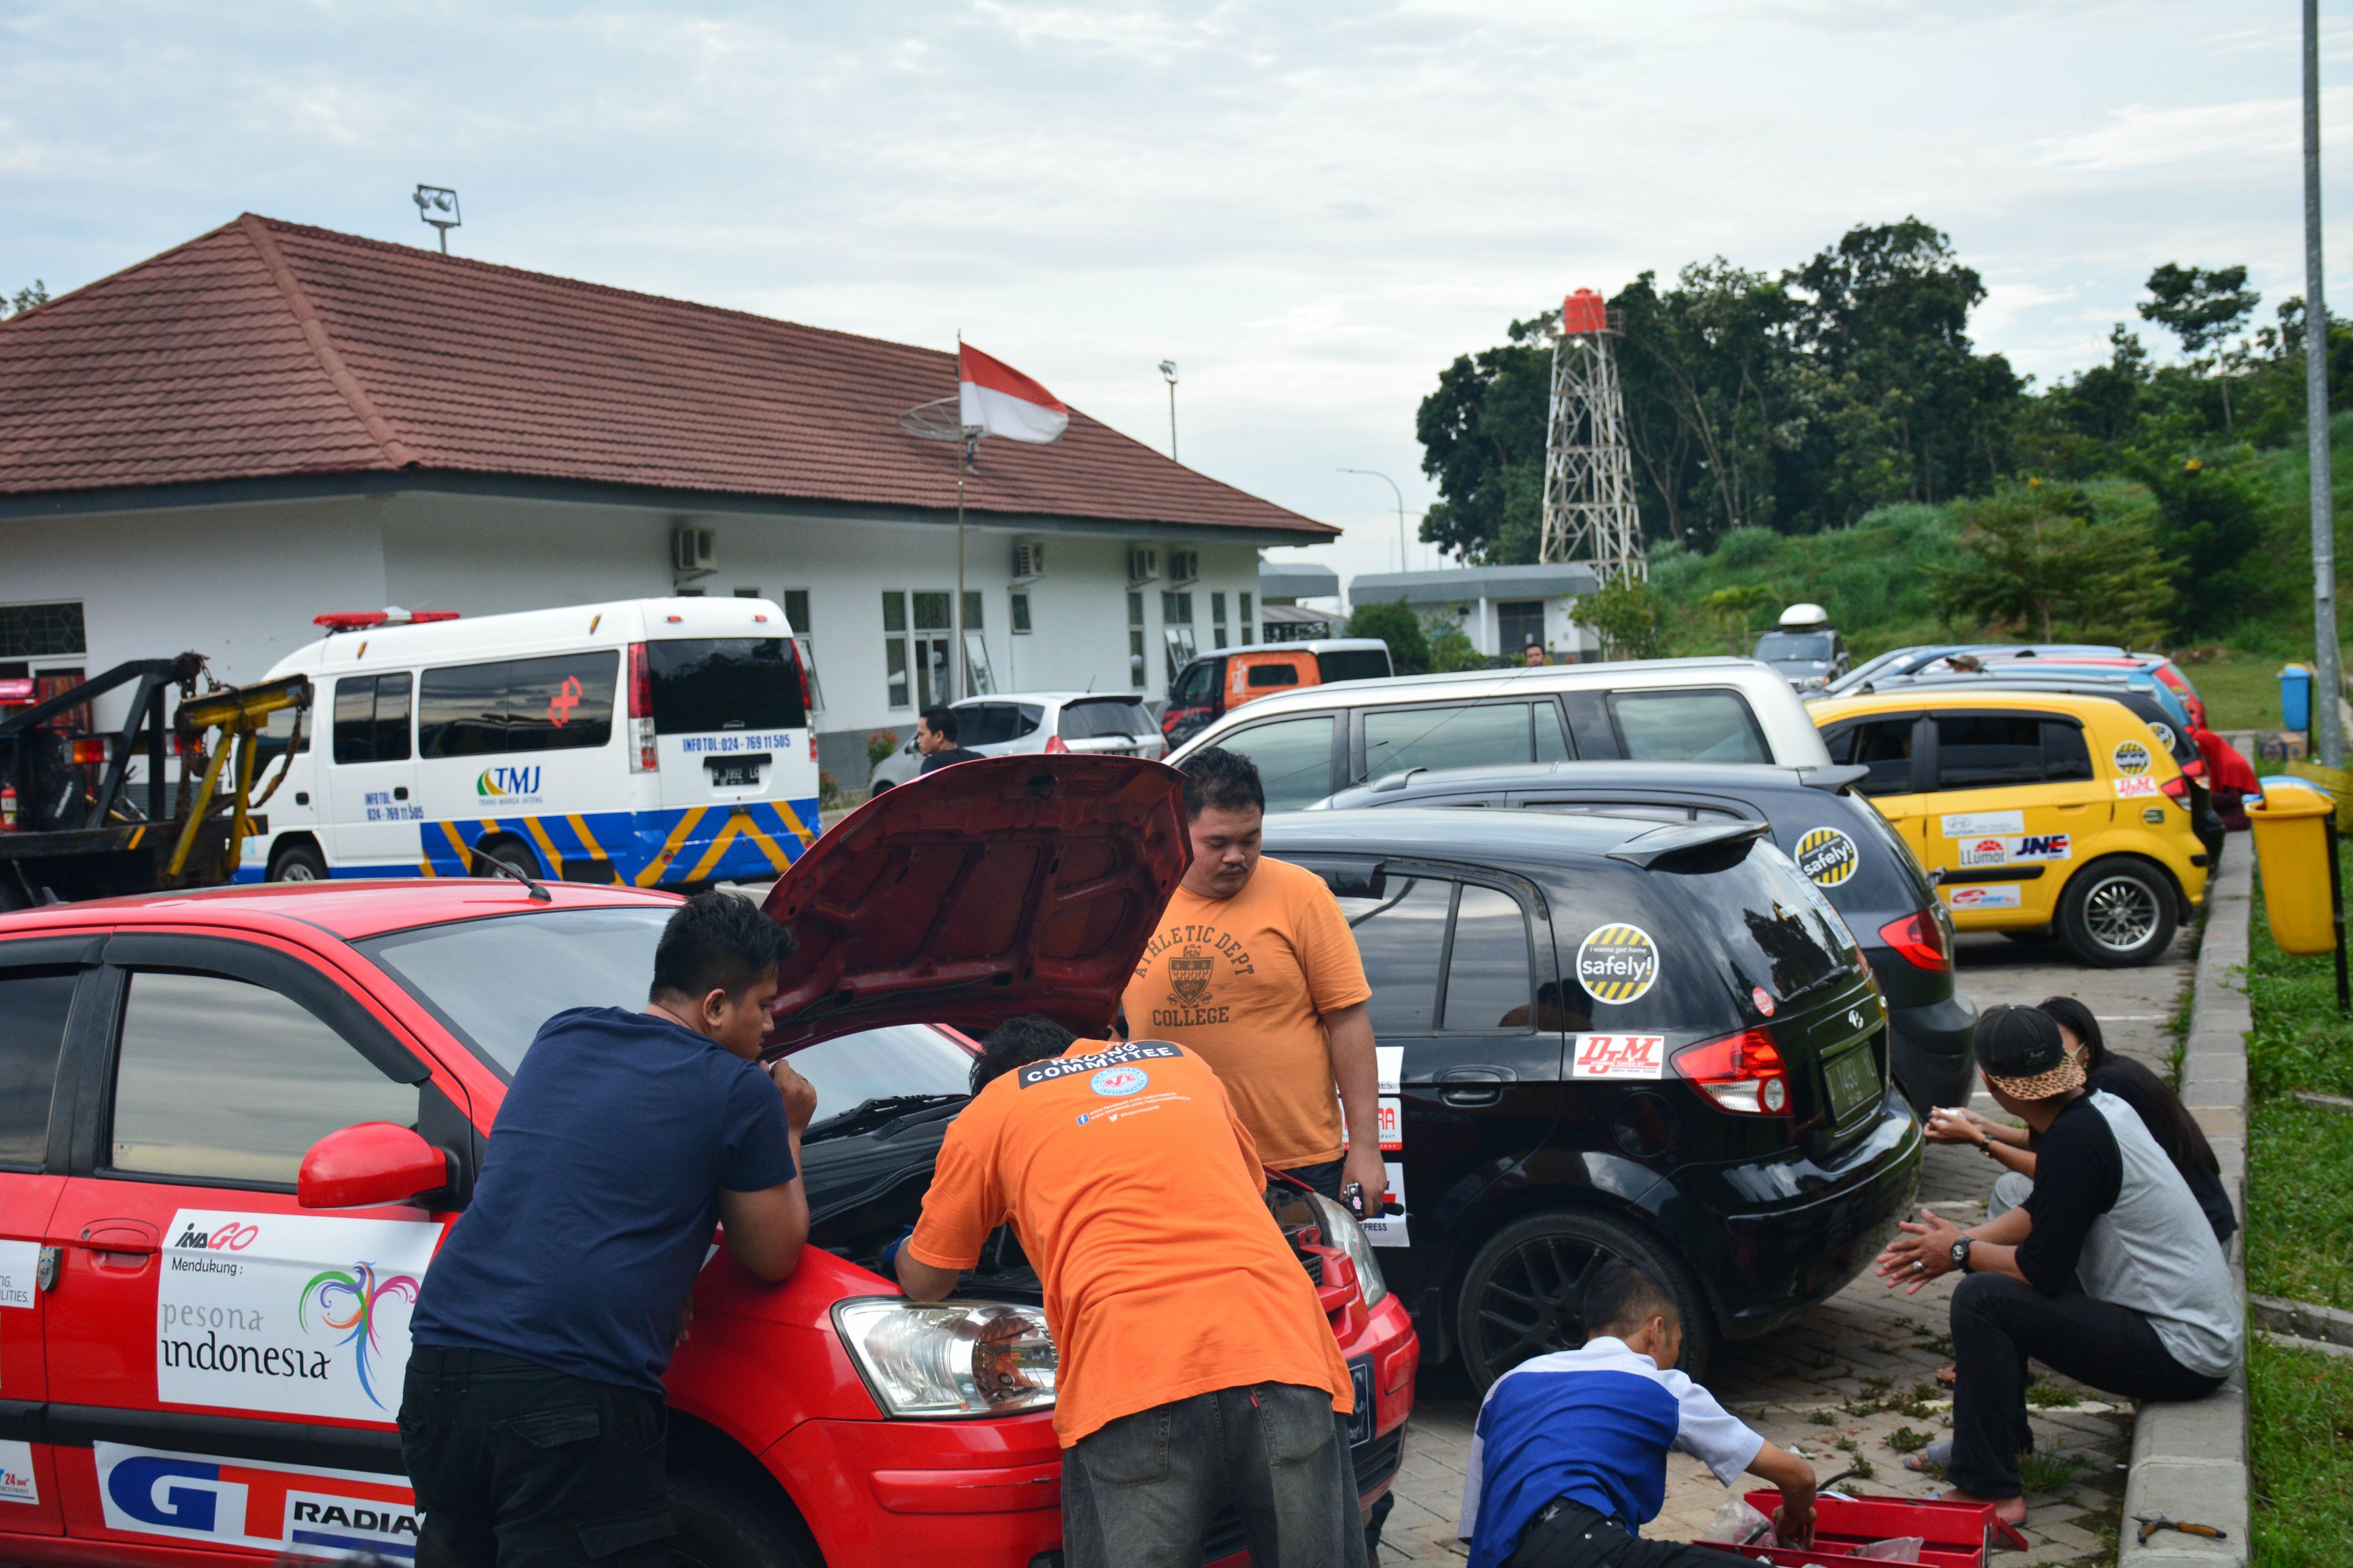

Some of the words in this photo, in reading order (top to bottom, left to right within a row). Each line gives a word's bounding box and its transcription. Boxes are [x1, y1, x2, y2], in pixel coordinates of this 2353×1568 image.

[683, 739, 701, 752] INFO
[746, 736, 761, 750] 769
[765, 736, 772, 749] 11
[774, 735, 790, 748] 505
[494, 766, 540, 794] TMJ
[1804, 840, 1853, 876] safely!
[2015, 836, 2068, 856] JNE
[1215, 932, 1254, 976] DEPT
[1582, 956, 1651, 981] safely!
[1152, 1006, 1229, 1027] COLLEGE
[1027, 1047, 1174, 1082] COMMITTEE
[1051, 1043, 1139, 1066] RACING
[172, 1257, 236, 1276] Mendukung
[0, 1290, 29, 1303] LITIES.
[162, 1303, 264, 1333] pesona
[161, 1330, 331, 1379] indonesia
[5, 1473, 15, 1486] 24
[294, 1501, 422, 1536] RADIA
